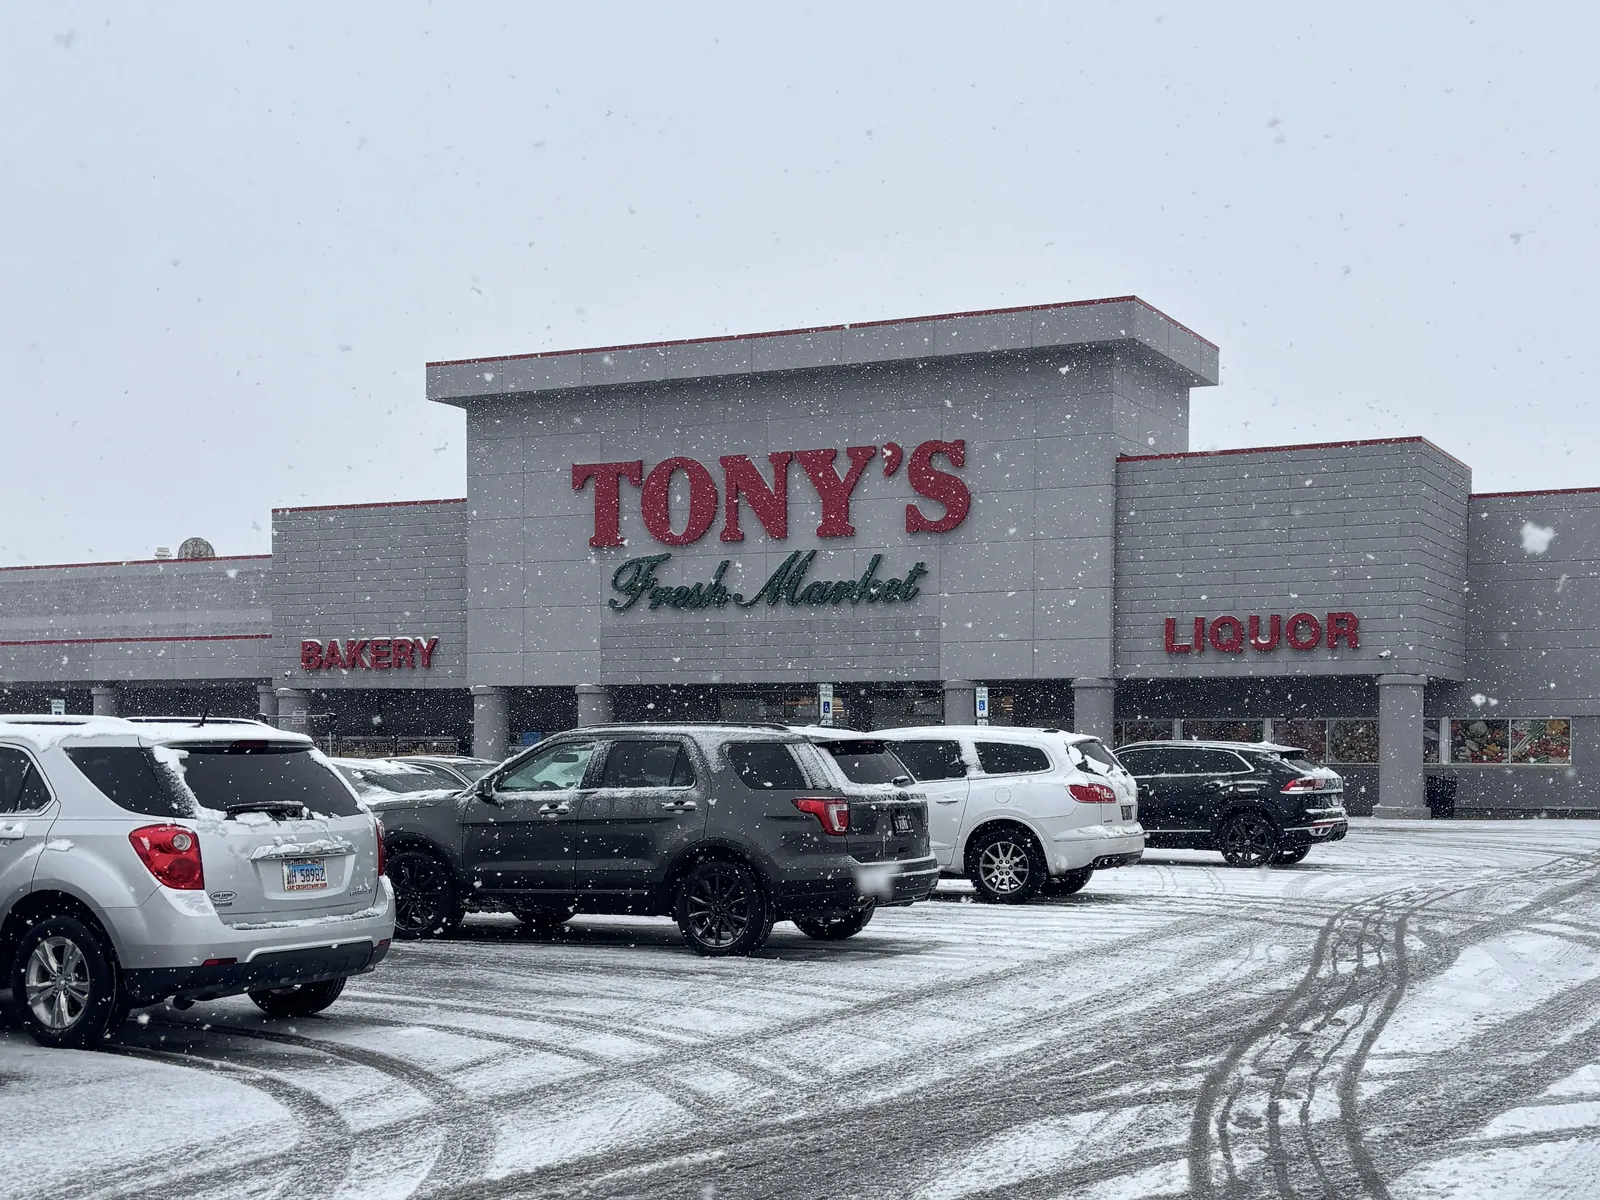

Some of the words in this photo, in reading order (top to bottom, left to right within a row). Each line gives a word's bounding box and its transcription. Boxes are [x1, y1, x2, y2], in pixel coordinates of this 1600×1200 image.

[571, 438, 971, 548] TONY'S
[608, 552, 733, 613] Fresh
[732, 549, 929, 608] Market
[300, 636, 439, 671] BAKERY
[1164, 612, 1360, 654] LIQUOR
